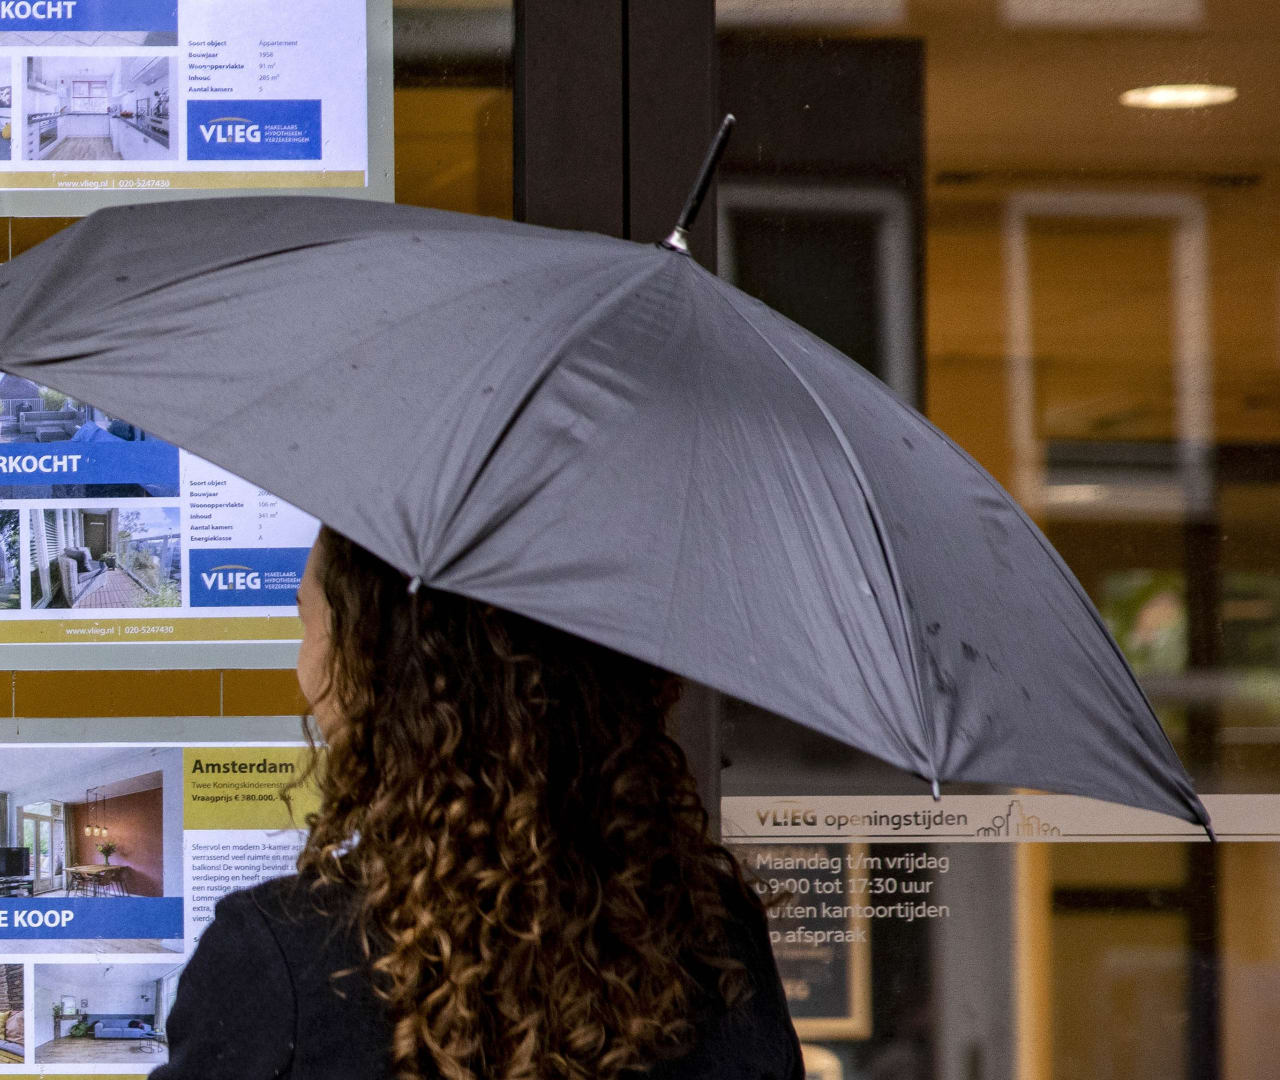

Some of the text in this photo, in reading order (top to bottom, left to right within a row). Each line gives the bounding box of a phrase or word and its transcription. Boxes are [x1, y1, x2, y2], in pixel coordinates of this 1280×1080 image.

[200, 125, 261, 143] VLIEG
[201, 572, 261, 590] VLIEG
[192, 758, 295, 774] Amsterdam
[191, 794, 233, 803] Vraagprijs
[757, 809, 968, 830] VLIEG openingstijden
[757, 853, 949, 874] Maandag t/m vrijdag
[814, 879, 843, 894] tot
[848, 878, 897, 894] 17:30
[902, 881, 934, 893] uur
[14, 910, 74, 927] KOOP
[822, 902, 950, 922] kantoortijden
[785, 926, 866, 947] afspraak
